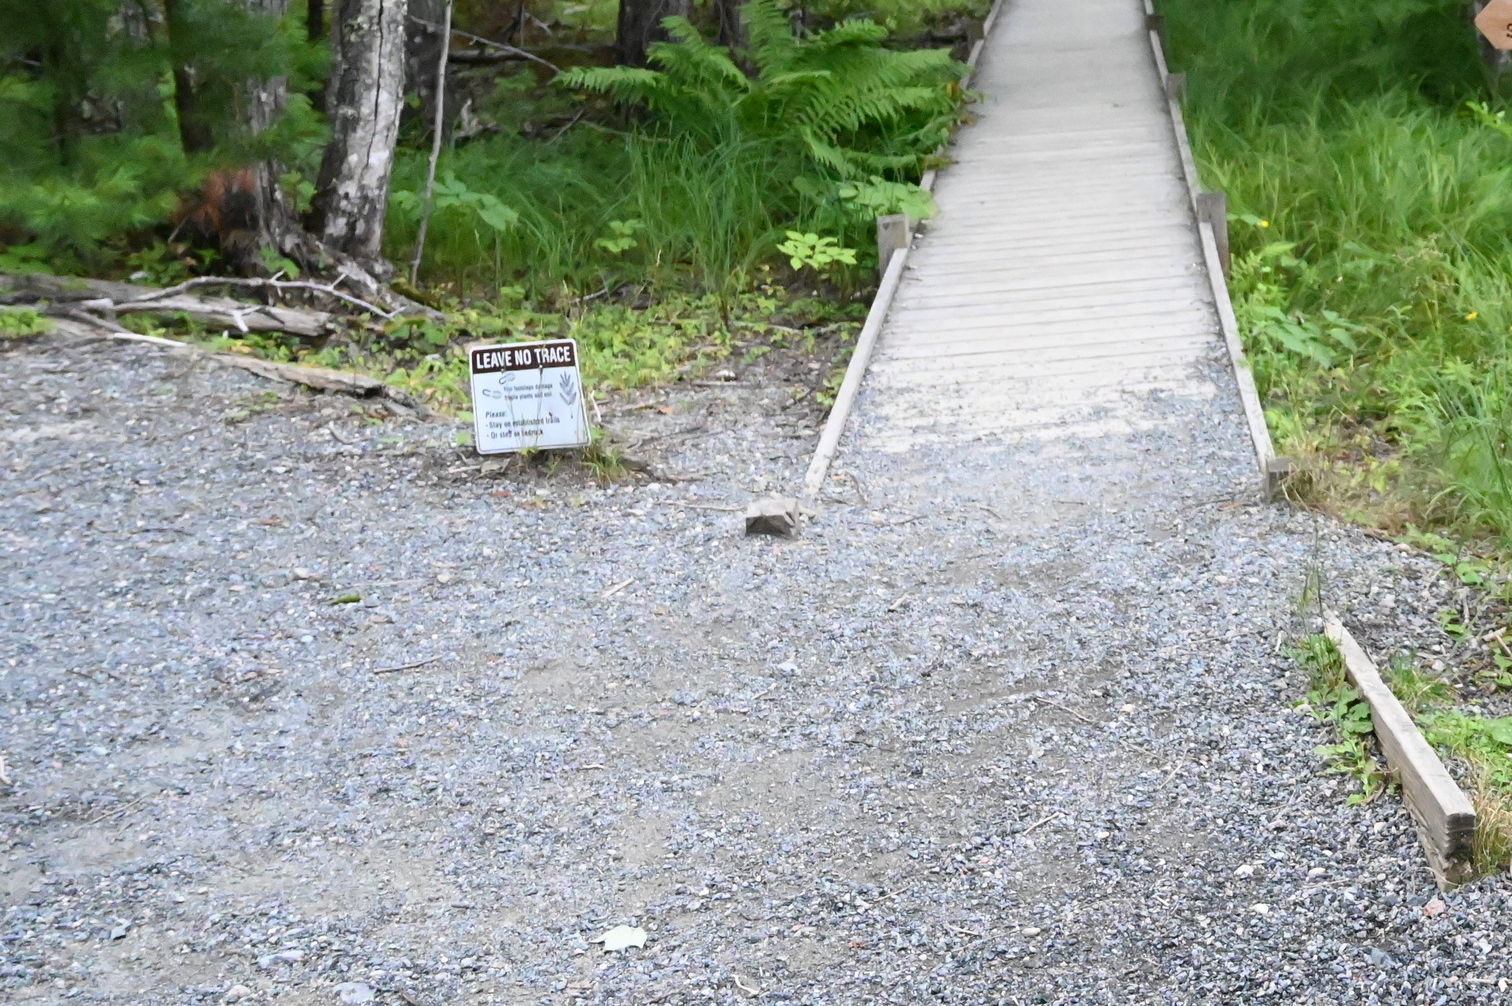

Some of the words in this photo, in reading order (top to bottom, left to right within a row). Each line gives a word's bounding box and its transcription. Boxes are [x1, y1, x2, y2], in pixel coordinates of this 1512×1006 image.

[476, 350, 512, 369] LEAVE
[514, 348, 532, 366] NO
[534, 346, 571, 364] TRACE
[490, 421, 502, 429] Stay
